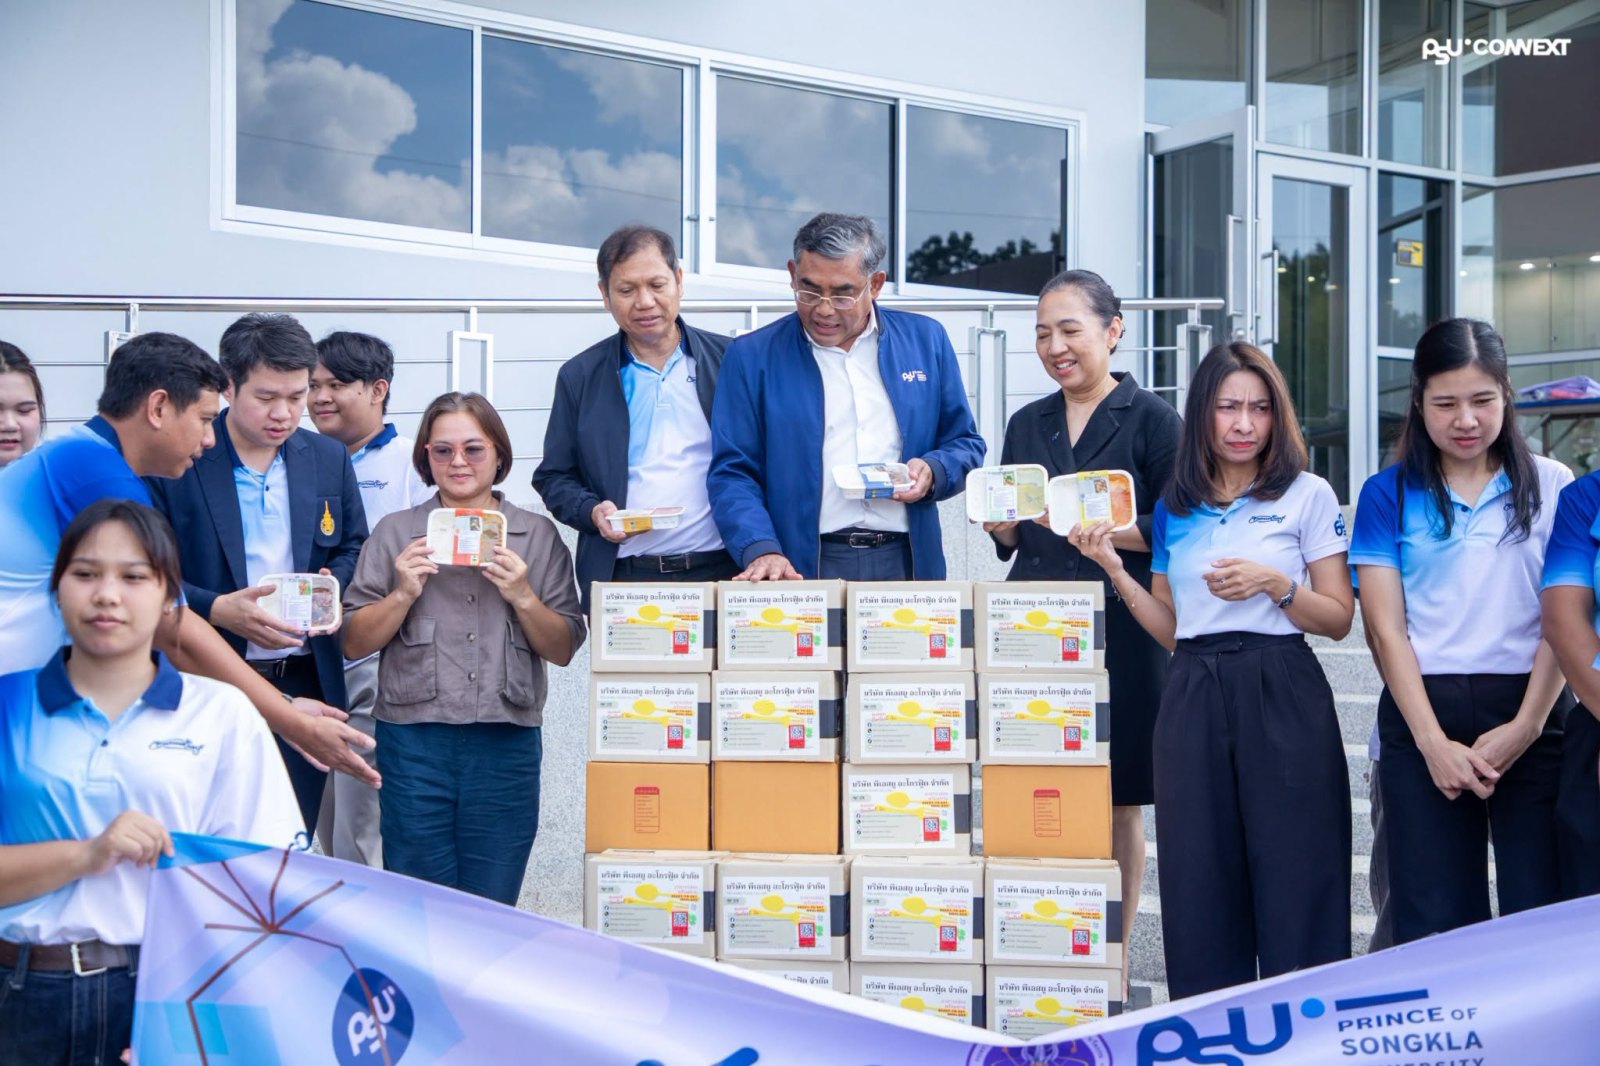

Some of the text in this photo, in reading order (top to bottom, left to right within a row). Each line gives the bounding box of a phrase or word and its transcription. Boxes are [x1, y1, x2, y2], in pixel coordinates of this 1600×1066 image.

[1337, 1007, 1478, 1033] PRINCE OF
[1340, 1030, 1484, 1056] SONGKLA
